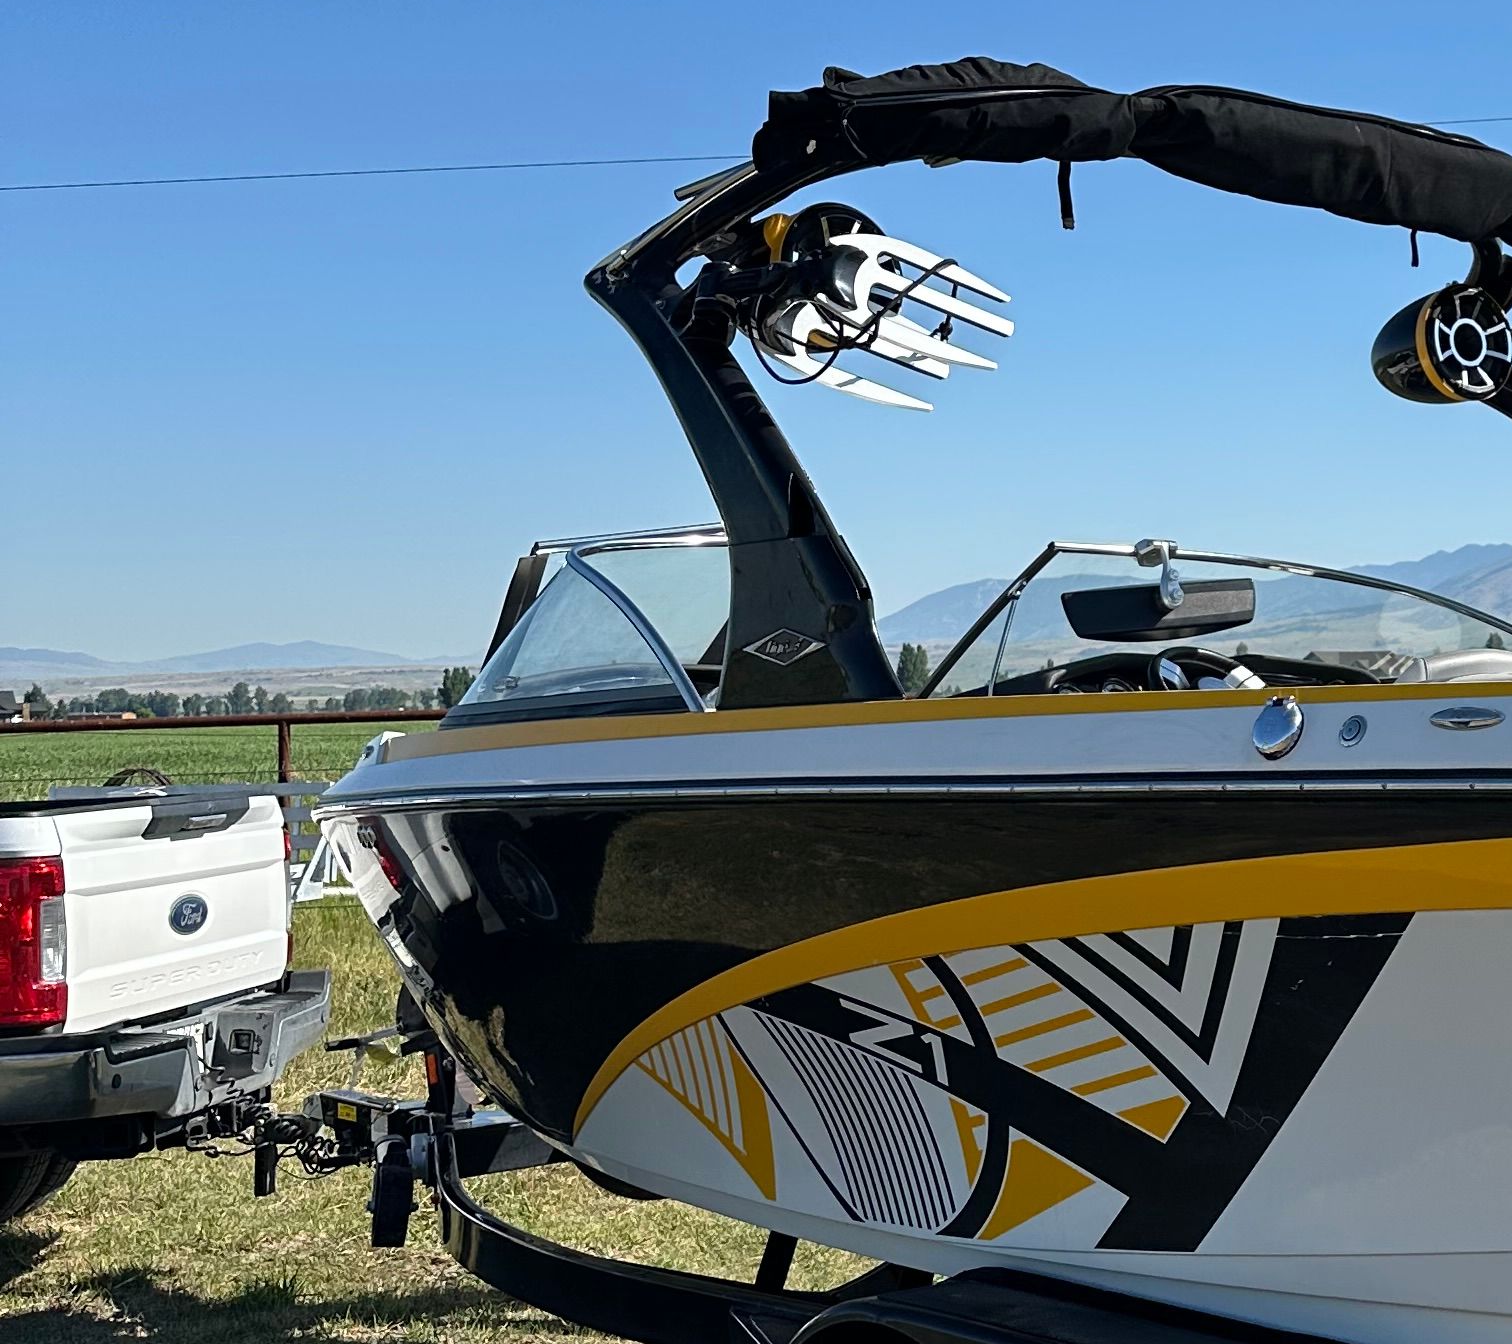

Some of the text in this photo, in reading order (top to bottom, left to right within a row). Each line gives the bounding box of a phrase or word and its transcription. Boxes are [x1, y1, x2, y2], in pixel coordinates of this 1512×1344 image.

[180, 902, 203, 927] Ford
[109, 950, 265, 999] SUPER DUTY
